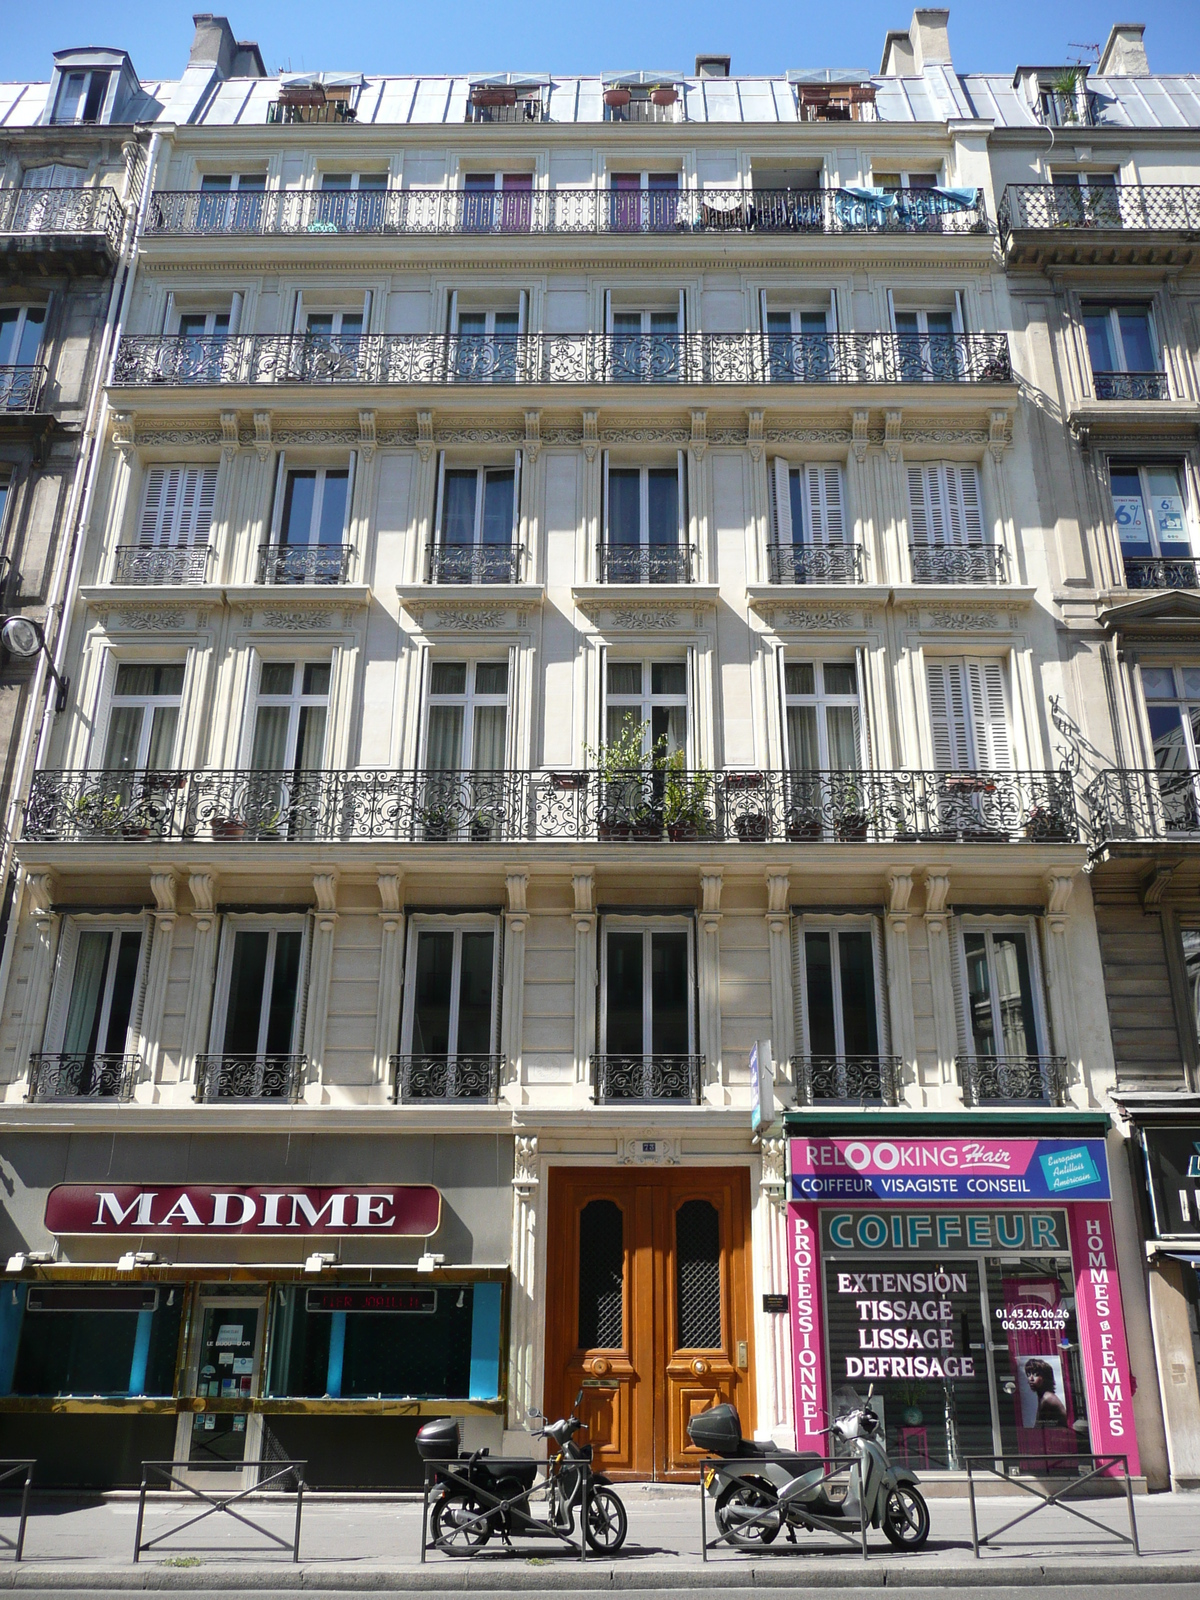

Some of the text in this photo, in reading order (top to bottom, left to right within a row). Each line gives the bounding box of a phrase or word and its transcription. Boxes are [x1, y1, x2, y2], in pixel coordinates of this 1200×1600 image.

[806, 1142, 1011, 1170] RELOOKING Hair
[1047, 1151, 1082, 1167] Européen
[1053, 1162, 1085, 1176] Antillais
[801, 1179, 1031, 1193] COIFFEUR VISAGISTE CONSEIL
[1053, 1172, 1091, 1189] Américain
[91, 1192, 397, 1228] MADIME
[828, 1213, 1060, 1249] COIFFEUR
[837, 1272, 968, 1294] EXTENSION
[856, 1300, 954, 1321] TISSAGE
[995, 1308, 1070, 1319] 01.45.26.06.26
[794, 1219, 818, 1436] PROFESSIONNEL
[1001, 1319, 1066, 1330] 06.30.55.21.79
[1085, 1219, 1110, 1317] HOMMES
[1100, 1333, 1124, 1437] FEMMES
[858, 1328, 955, 1350] LISSAGE
[845, 1356, 976, 1378] DEFRISAGE
